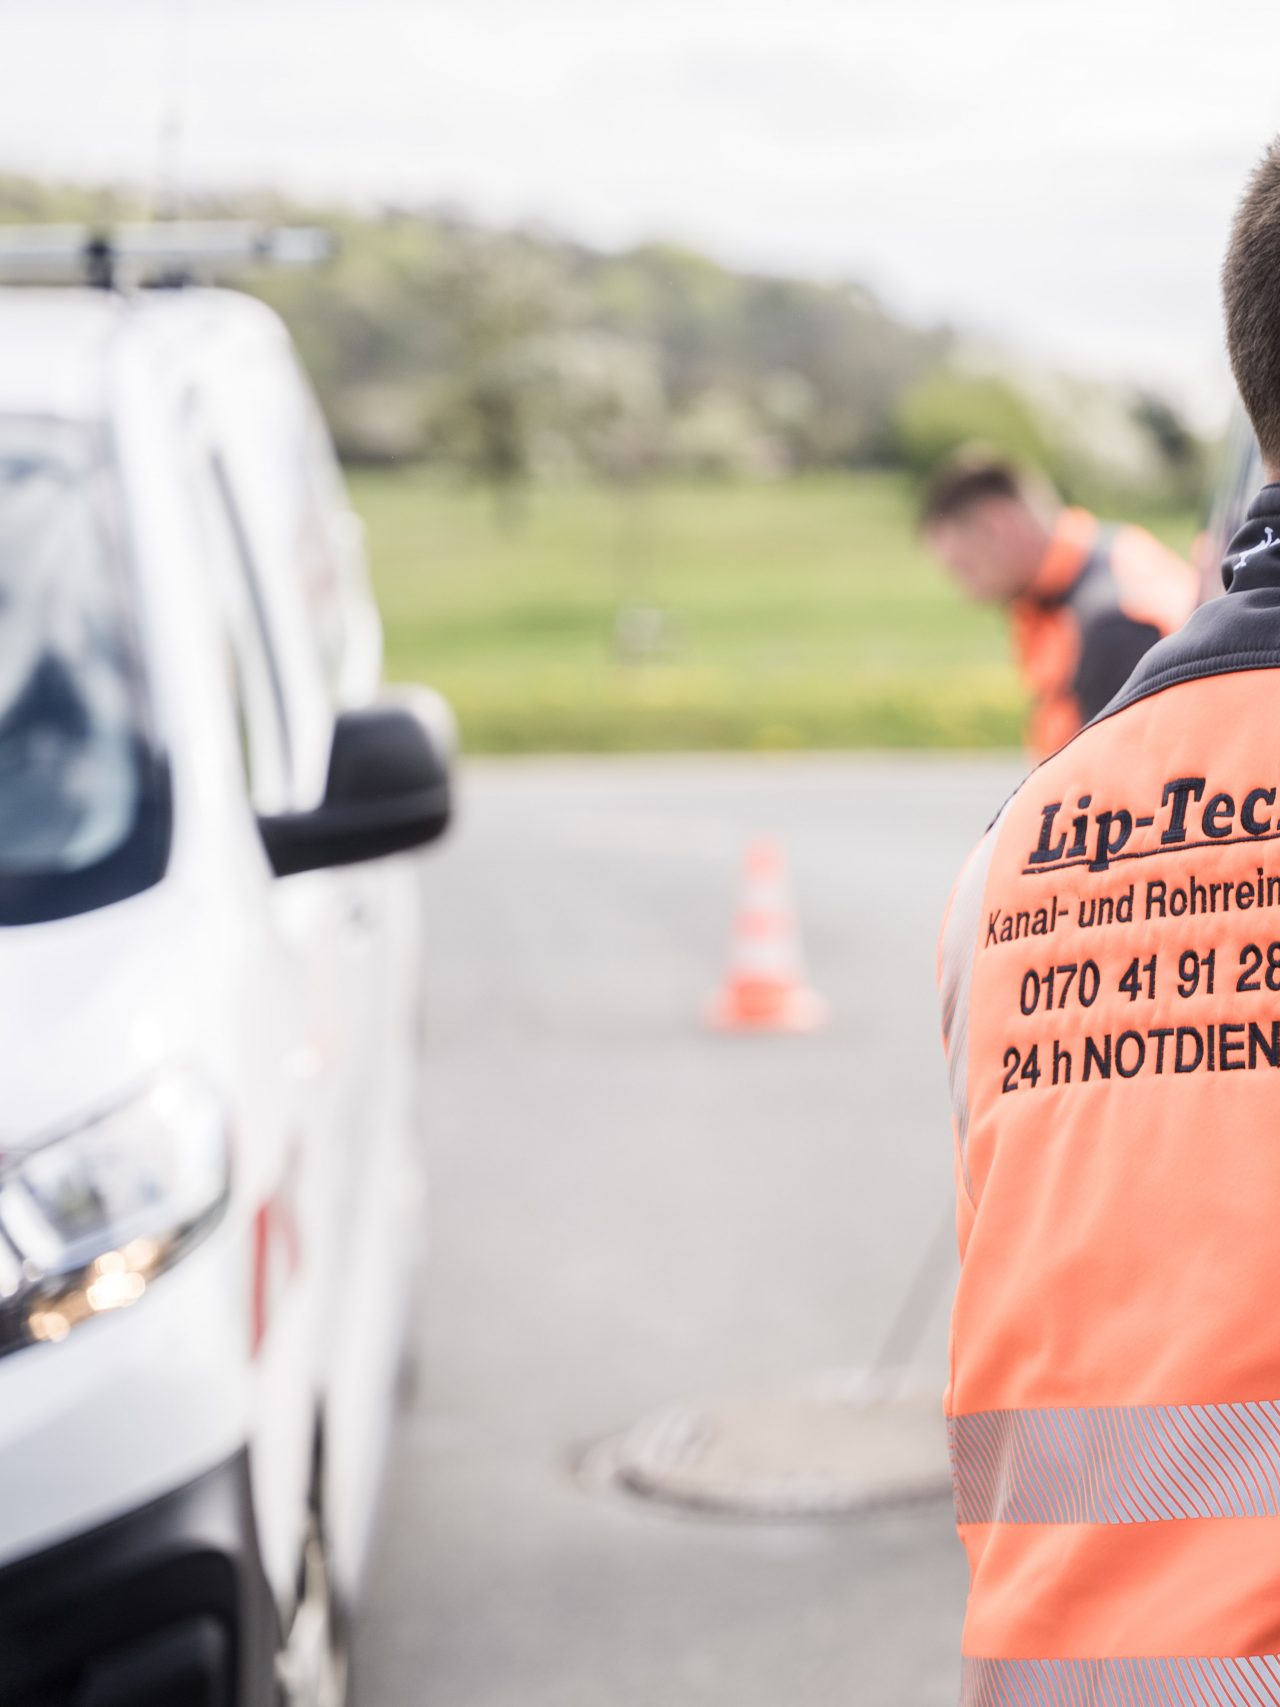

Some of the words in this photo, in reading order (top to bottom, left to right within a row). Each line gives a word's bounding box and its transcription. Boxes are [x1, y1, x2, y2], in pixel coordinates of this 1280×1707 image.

[985, 897, 1069, 948] Kanal-
[1078, 884, 1134, 929] und
[1020, 959, 1101, 1016] 0170
[1118, 954, 1157, 1001] 41
[1177, 948, 1216, 999] 91
[1002, 1044, 1041, 1094] 24
[1052, 1040, 1072, 1086] h
